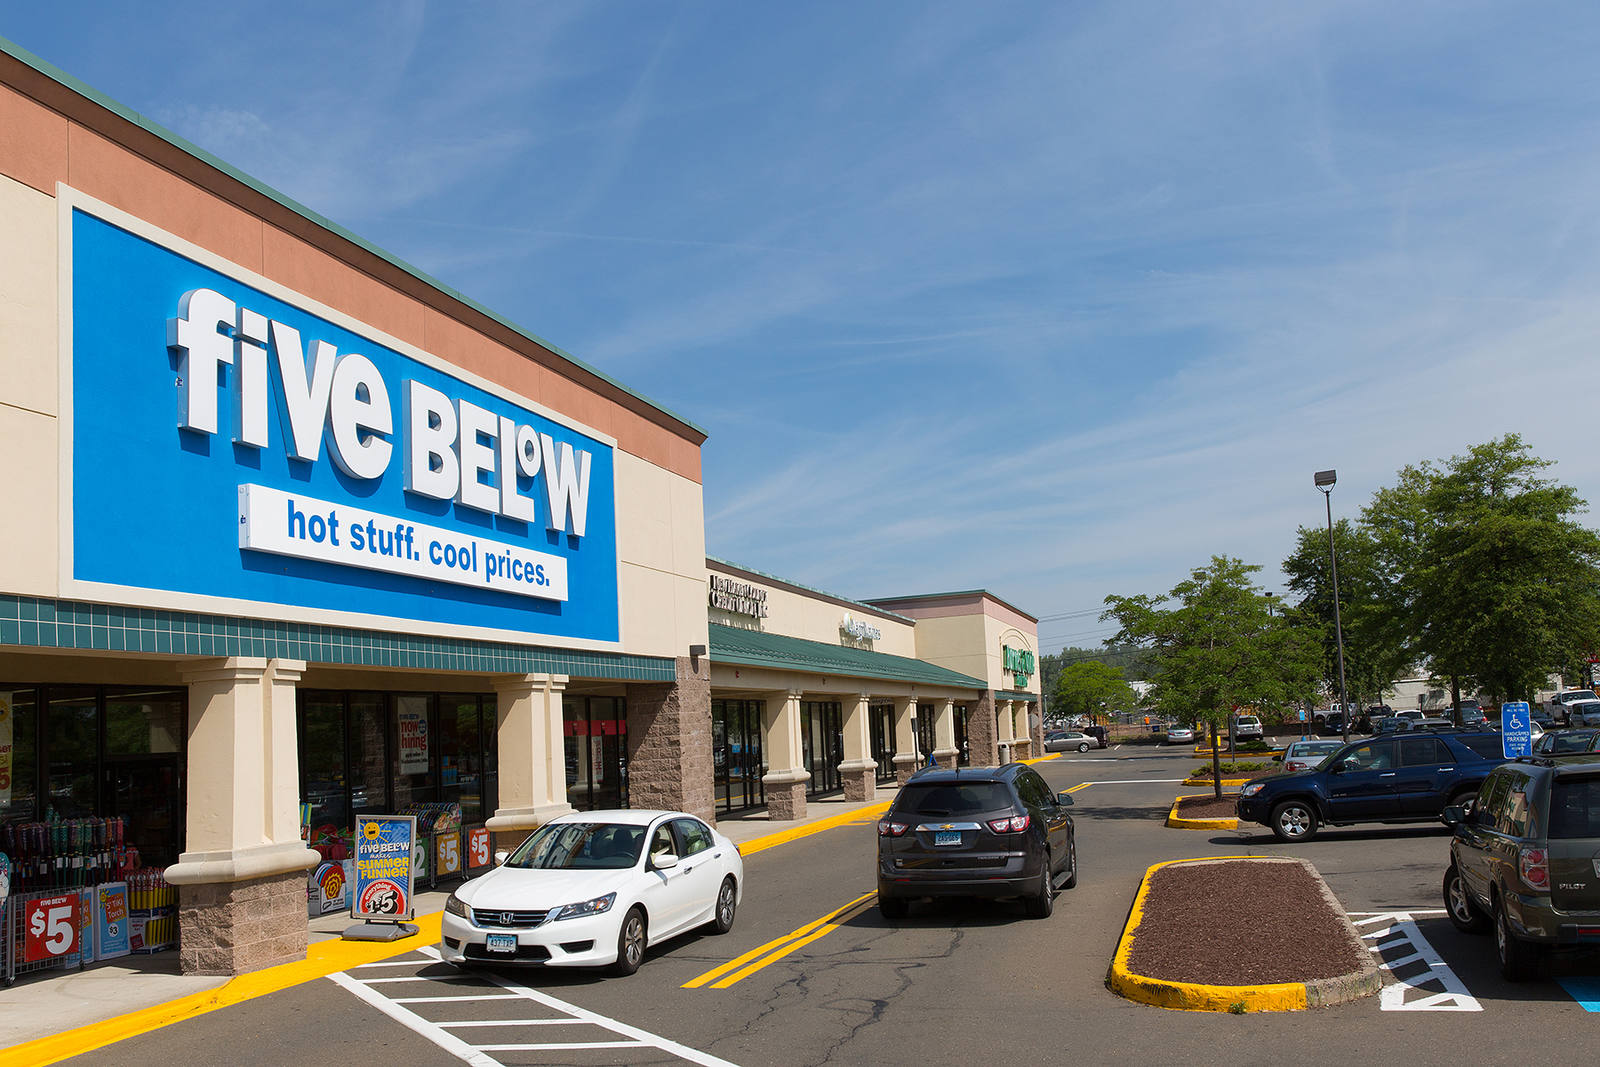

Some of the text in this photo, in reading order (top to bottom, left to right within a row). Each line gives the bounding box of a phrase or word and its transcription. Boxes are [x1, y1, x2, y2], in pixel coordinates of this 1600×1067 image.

[168, 287, 592, 538] five BELOW
[287, 499, 551, 587] hot stuff. cool prices.
[401, 733, 427, 751] hiring
[360, 842, 410, 854] five BELOW
[440, 840, 458, 871] $5
[471, 834, 489, 865] $5
[30, 905, 74, 955] $5
[109, 925, 118, 935] $3
